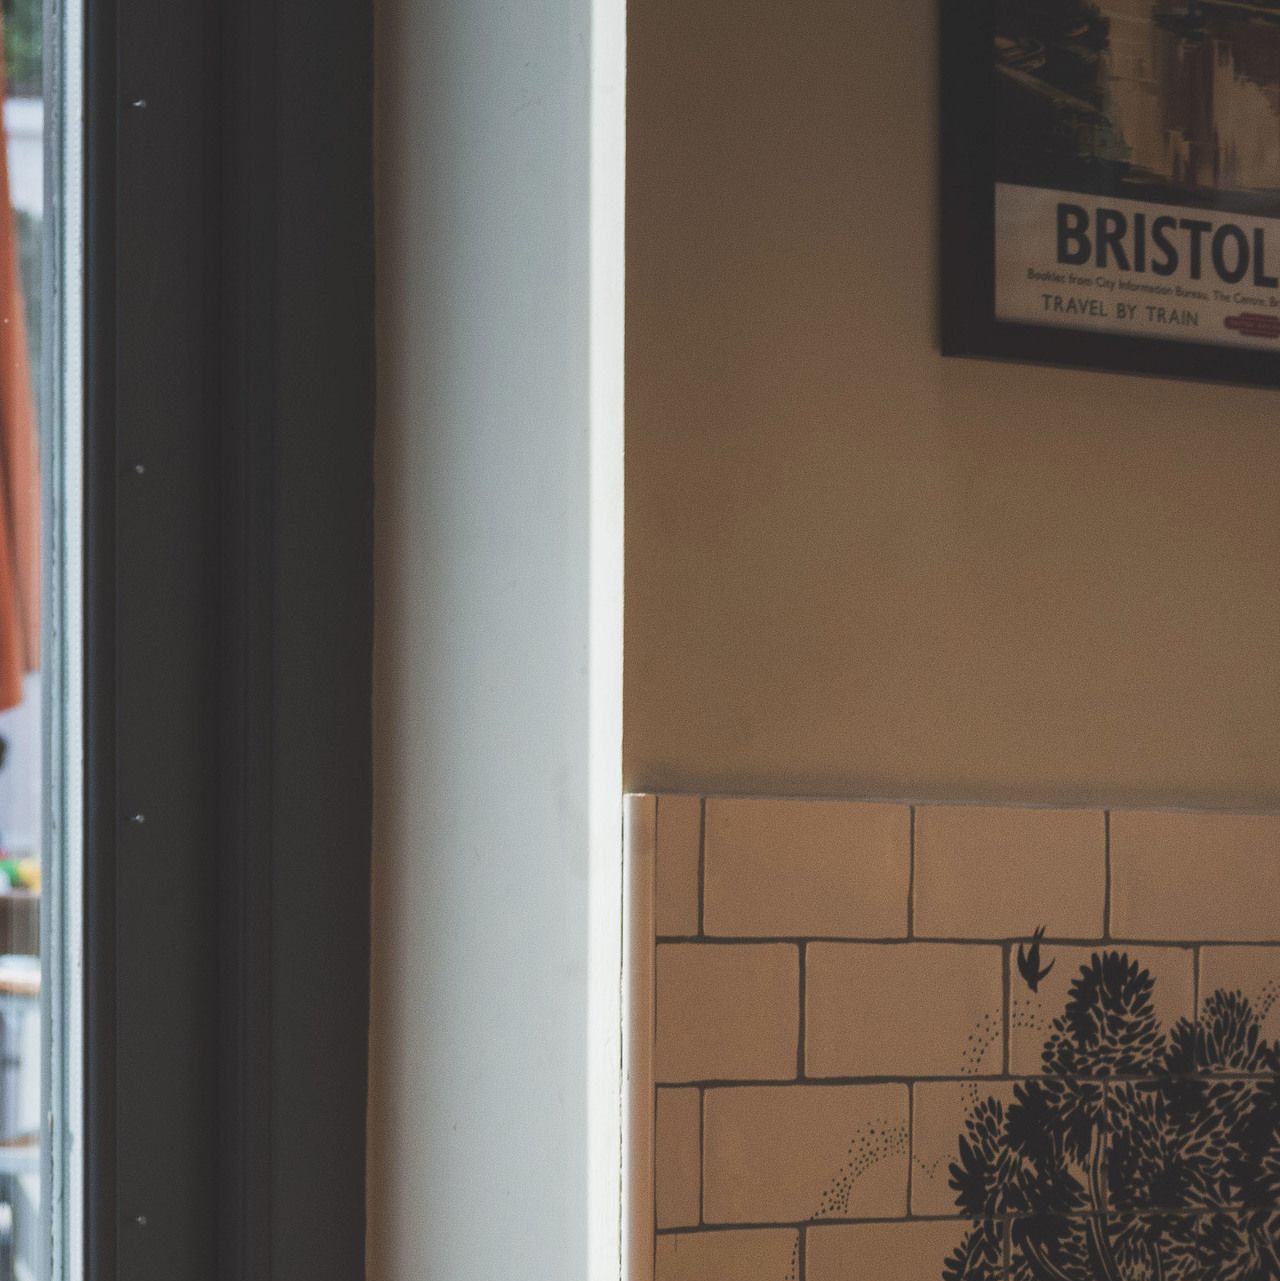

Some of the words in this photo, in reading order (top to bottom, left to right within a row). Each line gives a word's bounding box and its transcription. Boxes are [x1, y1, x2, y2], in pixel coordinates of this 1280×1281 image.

[1057, 202, 1279, 288] BRISTOL
[1027, 267, 1066, 284] Booklet
[1068, 274, 1092, 287] from
[1095, 277, 1115, 292] City
[1118, 280, 1174, 296] Information
[1213, 290, 1231, 303] The
[1042, 294, 1108, 317] TRAVEL
[1116, 302, 1137, 320] BY
[1146, 306, 1199, 326] TRAIN
